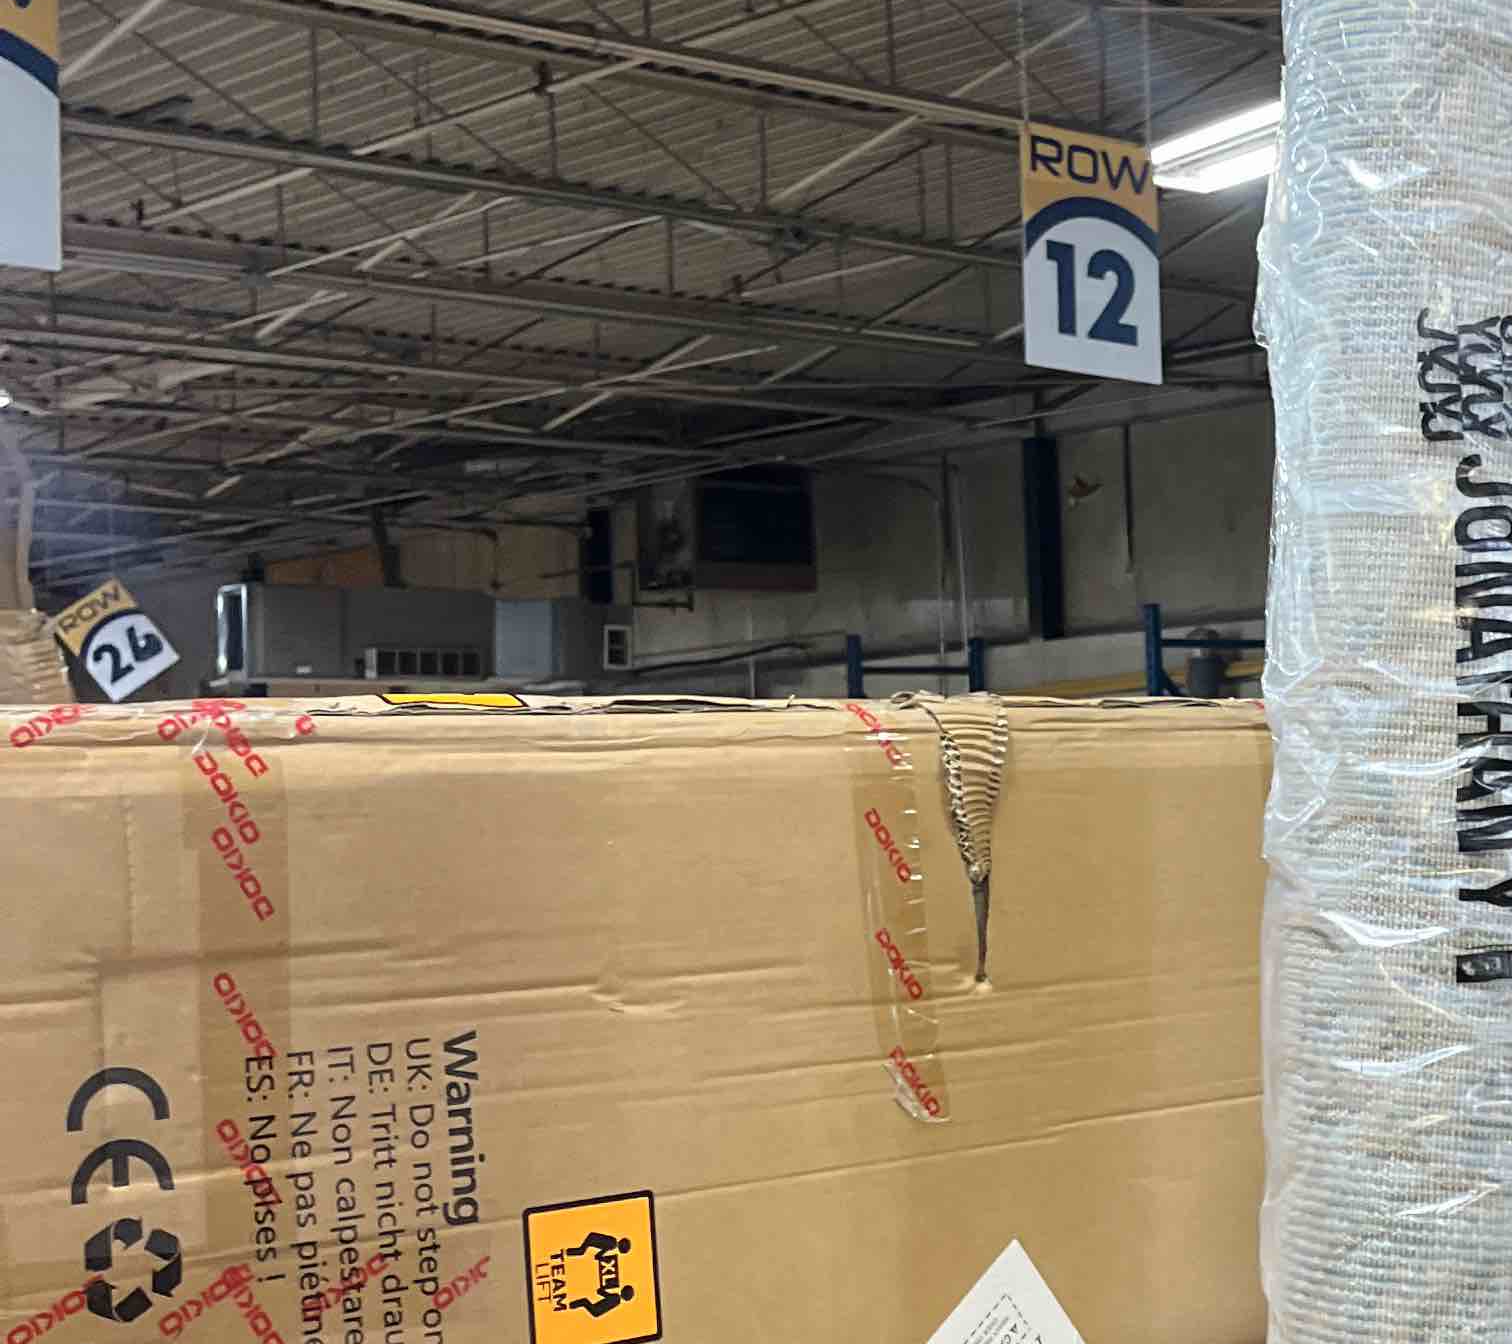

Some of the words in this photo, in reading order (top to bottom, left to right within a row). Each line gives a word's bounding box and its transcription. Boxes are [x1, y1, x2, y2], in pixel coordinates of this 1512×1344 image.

[1030, 135, 1149, 195] ROW
[1046, 239, 1138, 346] 12
[93, 625, 164, 685] 26
[245, 1056, 275, 1102] ES:
[288, 1050, 315, 1099] FR:
[327, 1046, 354, 1083] IT:
[367, 1042, 393, 1093] DE:
[406, 1038, 431, 1092] UK:
[248, 1116, 276, 1164] No
[290, 1112, 317, 1159] Ne
[330, 1095, 356, 1165] Non
[370, 1104, 398, 1169] Tritt
[409, 1104, 435, 1149] Do
[444, 1030, 485, 1226] Warning
[287, 1172, 318, 1227] pas
[413, 1163, 438, 1216] not
[375, 1181, 403, 1261] nicht
[414, 1227, 442, 1296] step
[535, 1263, 552, 1304] LIFT
[551, 1248, 568, 1312] TEAM
[599, 1258, 617, 1287] XL
